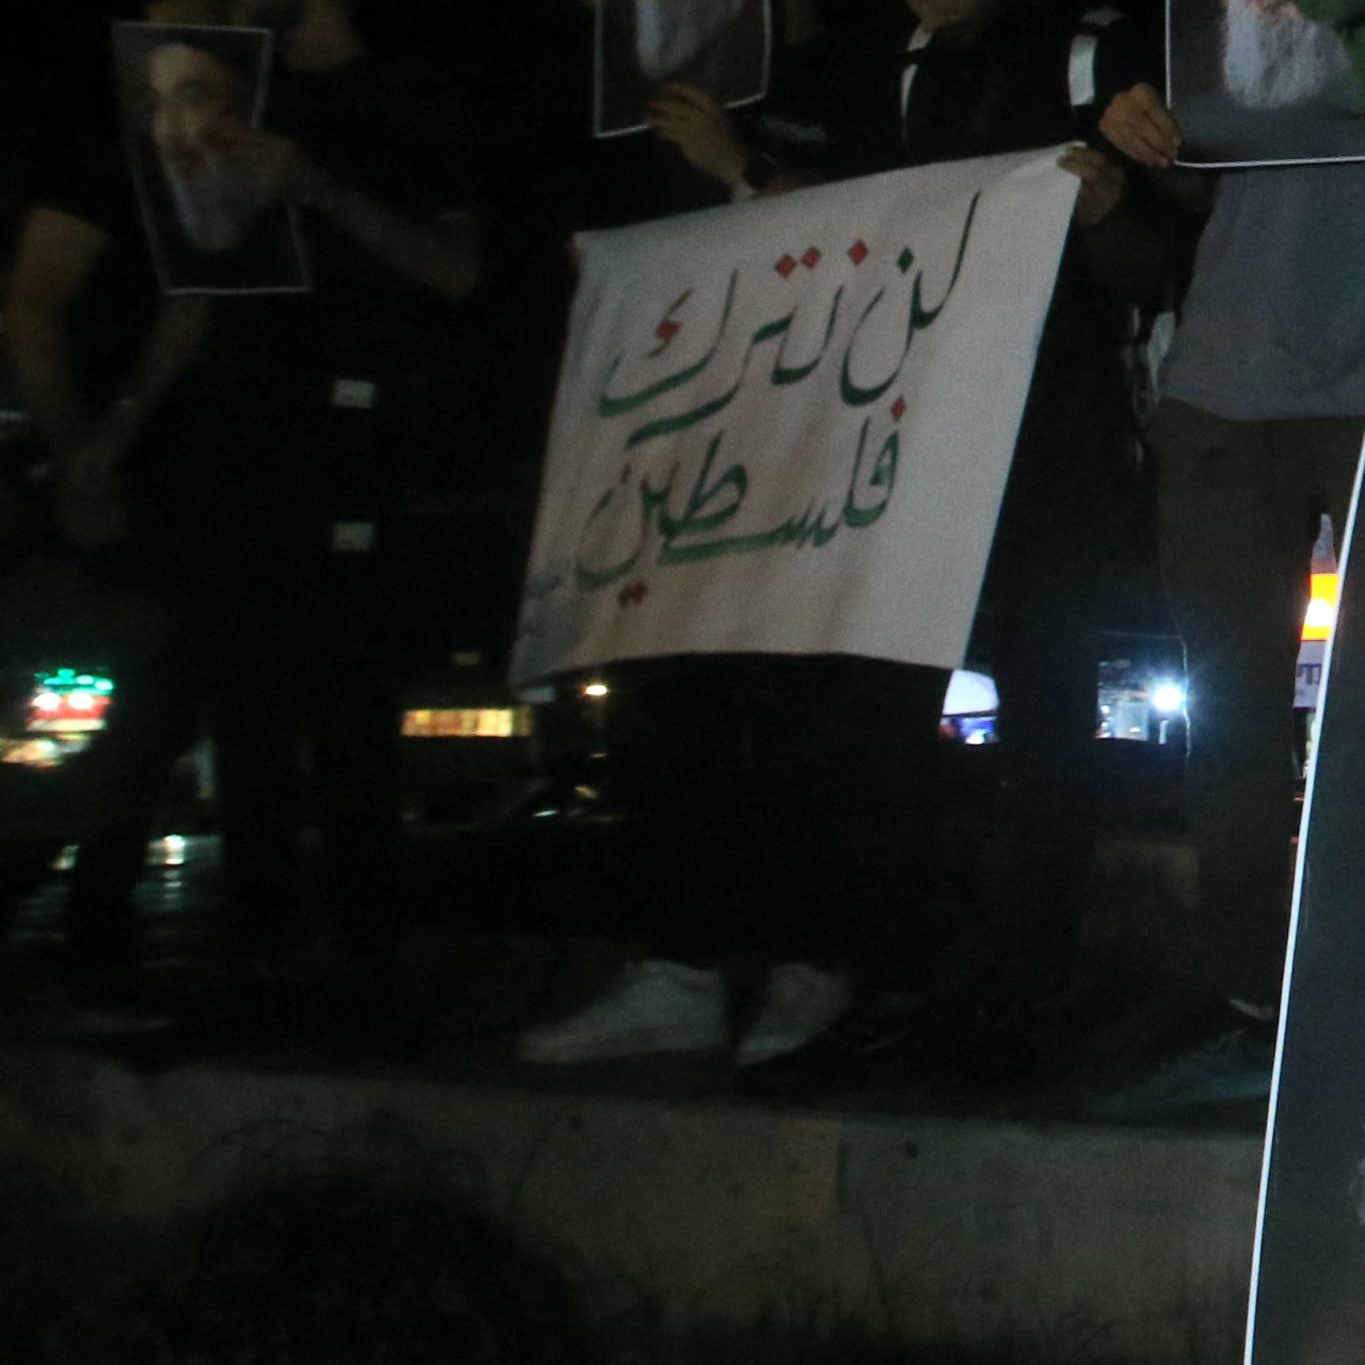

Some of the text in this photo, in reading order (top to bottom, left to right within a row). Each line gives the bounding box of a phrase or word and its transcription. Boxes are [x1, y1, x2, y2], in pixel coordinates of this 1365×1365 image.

[598, 190, 981, 451] لن نترك
[575, 397, 906, 608] فلسطين
